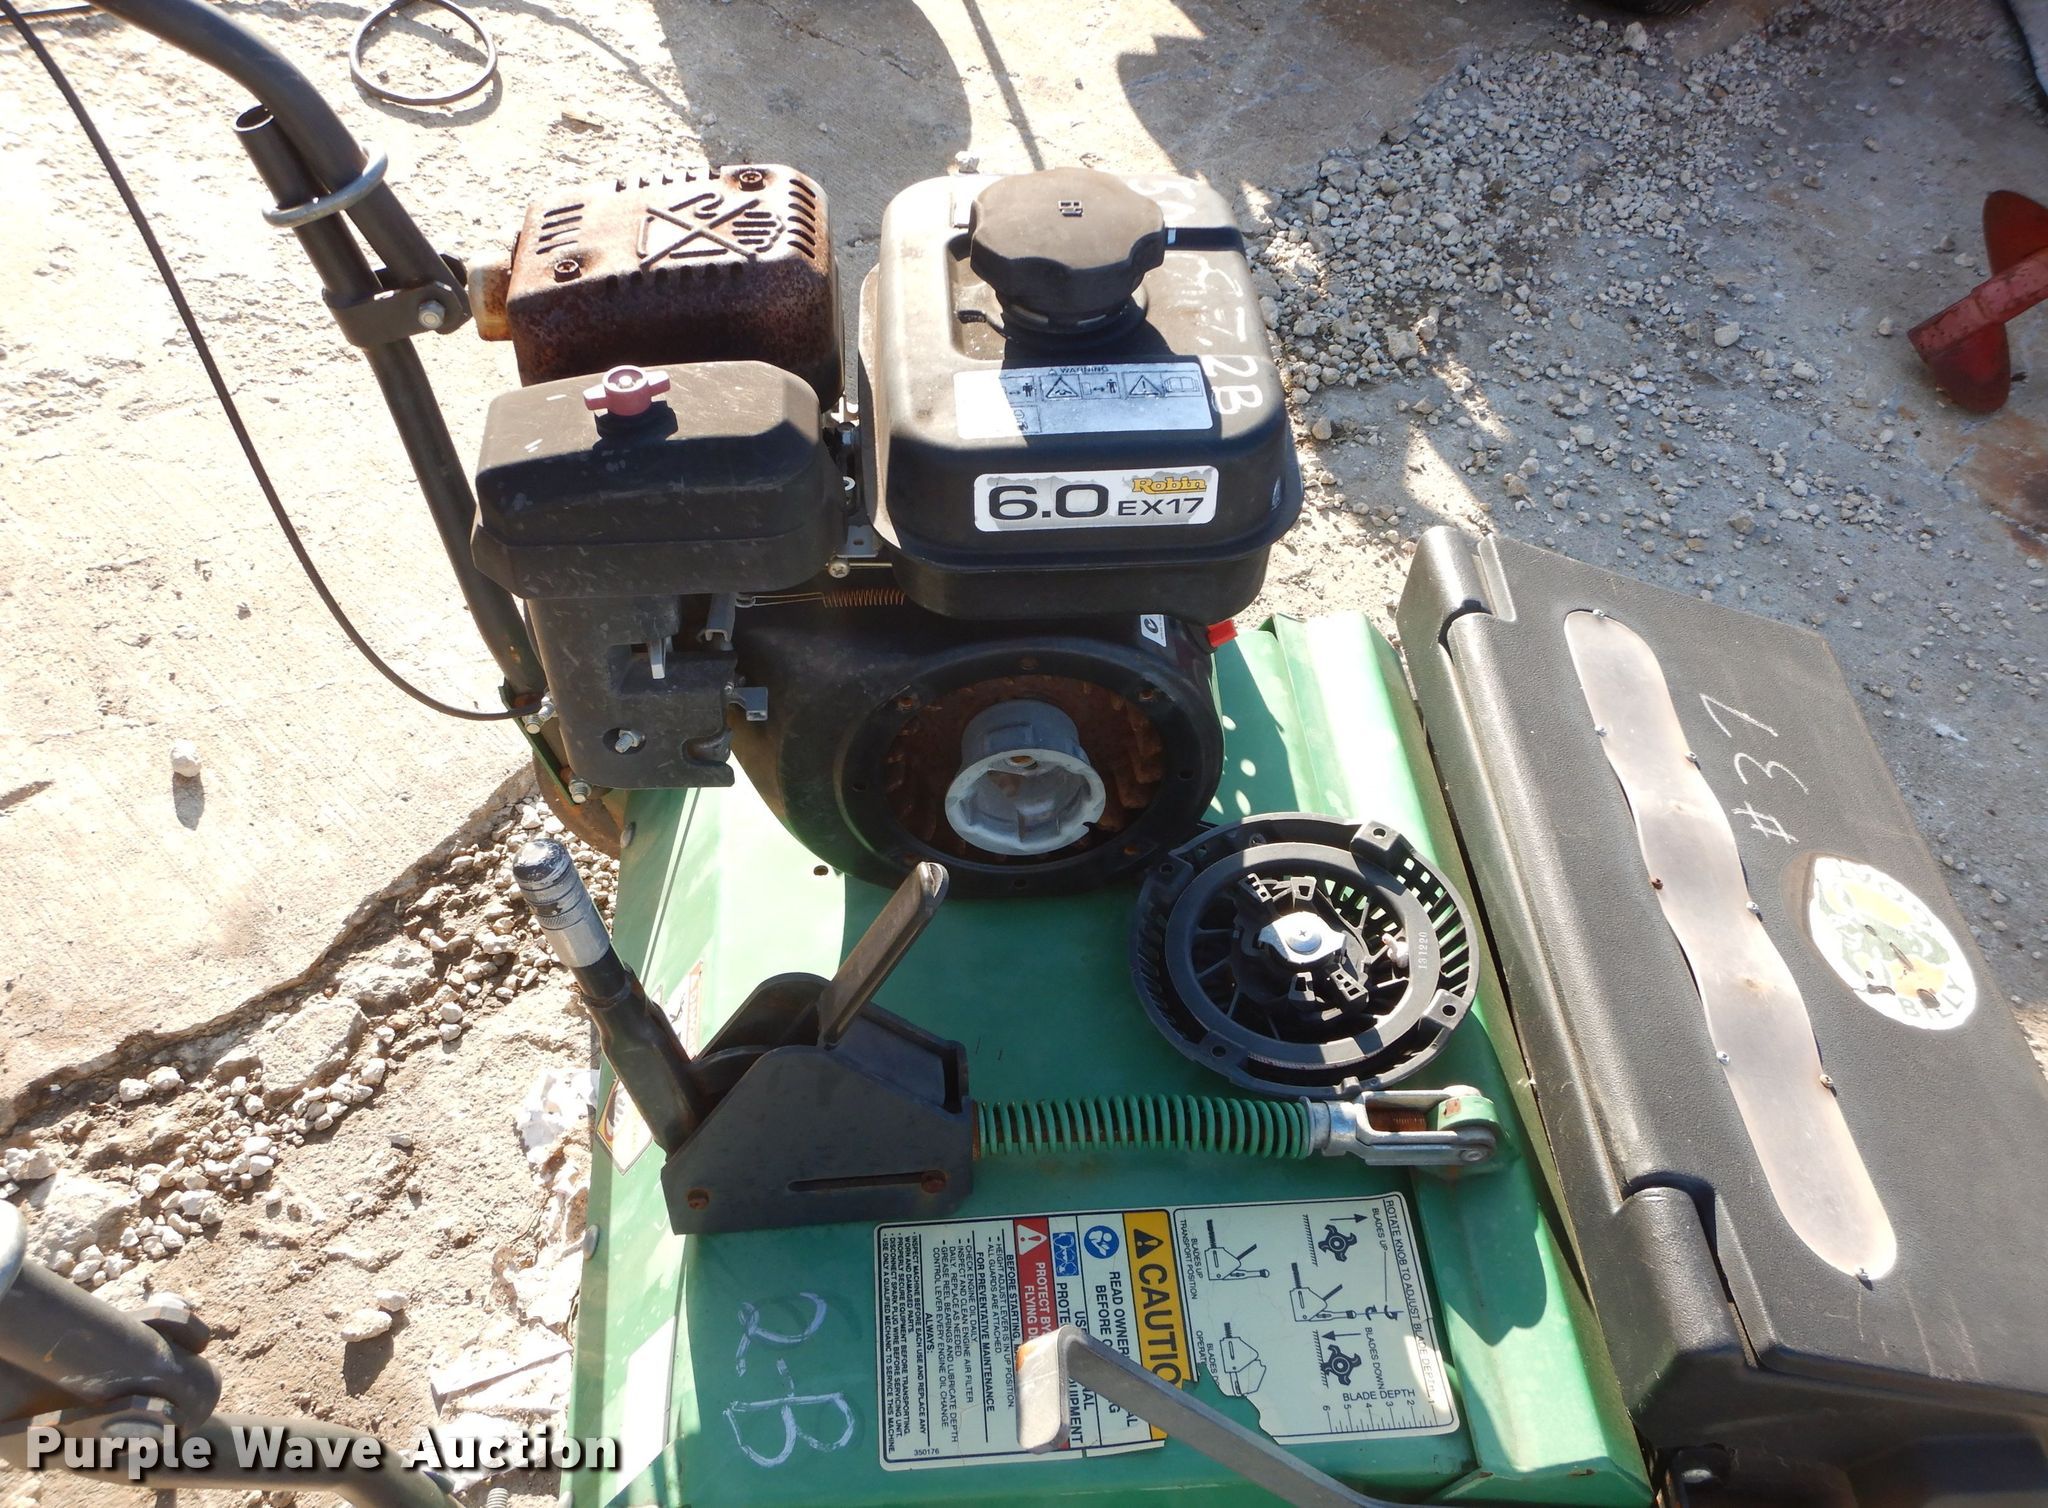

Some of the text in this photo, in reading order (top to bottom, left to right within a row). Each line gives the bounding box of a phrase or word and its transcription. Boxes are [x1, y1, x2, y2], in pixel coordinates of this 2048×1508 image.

[1060, 365, 1109, 373] WARNING
[988, 484, 1204, 521] 6.0 EX17
[1132, 476, 1208, 495] Robin
[1372, 1208, 1388, 1251] BLADES UP
[1386, 1200, 1402, 1236] ROTATE
[1180, 1219, 1198, 1300] TRANSPORT POSITION
[1191, 1238, 1203, 1279] BLADES UP
[1394, 1238, 1408, 1265] KNOB
[1007, 1254, 1016, 1291] BEFORE
[1036, 1262, 1050, 1313] PROTECT
[1109, 1271, 1124, 1305] READ
[1401, 1267, 1412, 1281] TO
[1024, 1285, 1038, 1324] FLYING
[1095, 1285, 1112, 1336] BEFORE
[1405, 1283, 1420, 1320] ADJUST
[925, 1312, 935, 1353] ALWAYS:
[976, 1252, 995, 1412] FOR PREVENTATIVE MAINTENANCE
[1138, 1264, 1183, 1386] CAUTIO
[1414, 1323, 1428, 1353] BLADE
[1206, 1343, 1218, 1374] BLADES
[1365, 1327, 1386, 1389] BLADES DOWN
[1342, 1389, 1415, 1401] BLADE DEPTH
[914, 1448, 939, 1456] 350176
